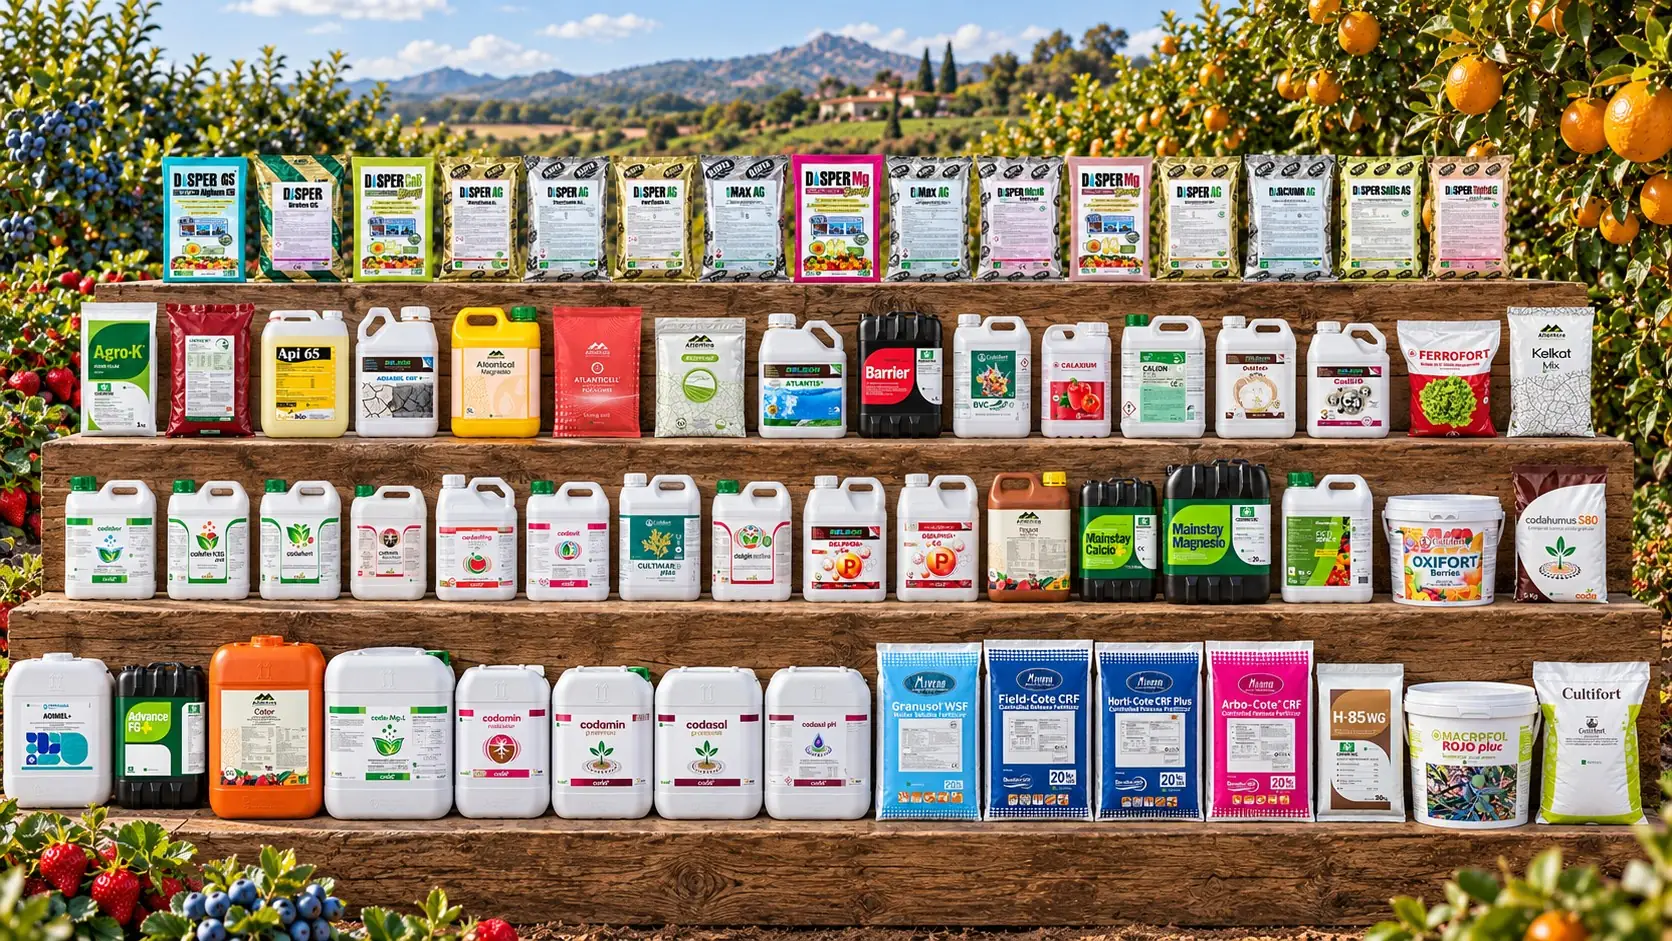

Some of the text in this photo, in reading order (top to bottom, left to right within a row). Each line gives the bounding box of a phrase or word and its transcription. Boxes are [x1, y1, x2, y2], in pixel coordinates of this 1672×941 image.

[805, 171, 870, 188] DISPER Mg
[1082, 173, 1140, 188] DISPER Mg
[492, 186, 503, 198] AG
[578, 186, 589, 198] AG
[666, 186, 677, 198] AG
[753, 186, 764, 198] AG
[938, 186, 949, 198] AG
[1210, 186, 1222, 198] AG
[1306, 186, 1316, 197] AG
[1401, 185, 1411, 196] AS
[94, 344, 143, 362] Agro-K
[278, 348, 320, 362] Api 65
[1419, 349, 1490, 361] FERROFORT
[1532, 347, 1571, 359] Kelkat
[1543, 362, 1559, 370] Mix
[865, 366, 910, 379] Barrier
[1525, 515, 1599, 525] codahumus S80
[1172, 523, 1224, 536] Mainstay
[1086, 532, 1131, 545] Mainstay
[1172, 536, 1226, 550] Magnesio
[1086, 545, 1116, 555] Calcio
[844, 559, 856, 573] P
[936, 553, 949, 569] P
[1412, 555, 1477, 569] OXIFORT
[999, 694, 1080, 704] Field-Cote CRF
[1562, 687, 1622, 700] Cultifort
[892, 702, 968, 712] Granusol WSF
[1108, 696, 1192, 706] Horti-Cote CRF Plus
[1283, 700, 1302, 709] CRF
[128, 712, 169, 722] Advance
[482, 714, 521, 723] codamin
[580, 719, 626, 729] codamin
[686, 720, 728, 729] codasal
[1443, 741, 1476, 752] ROJO
[1050, 771, 1065, 783] 20
[1161, 774, 1175, 785] 20
[1272, 777, 1285, 788] 20
